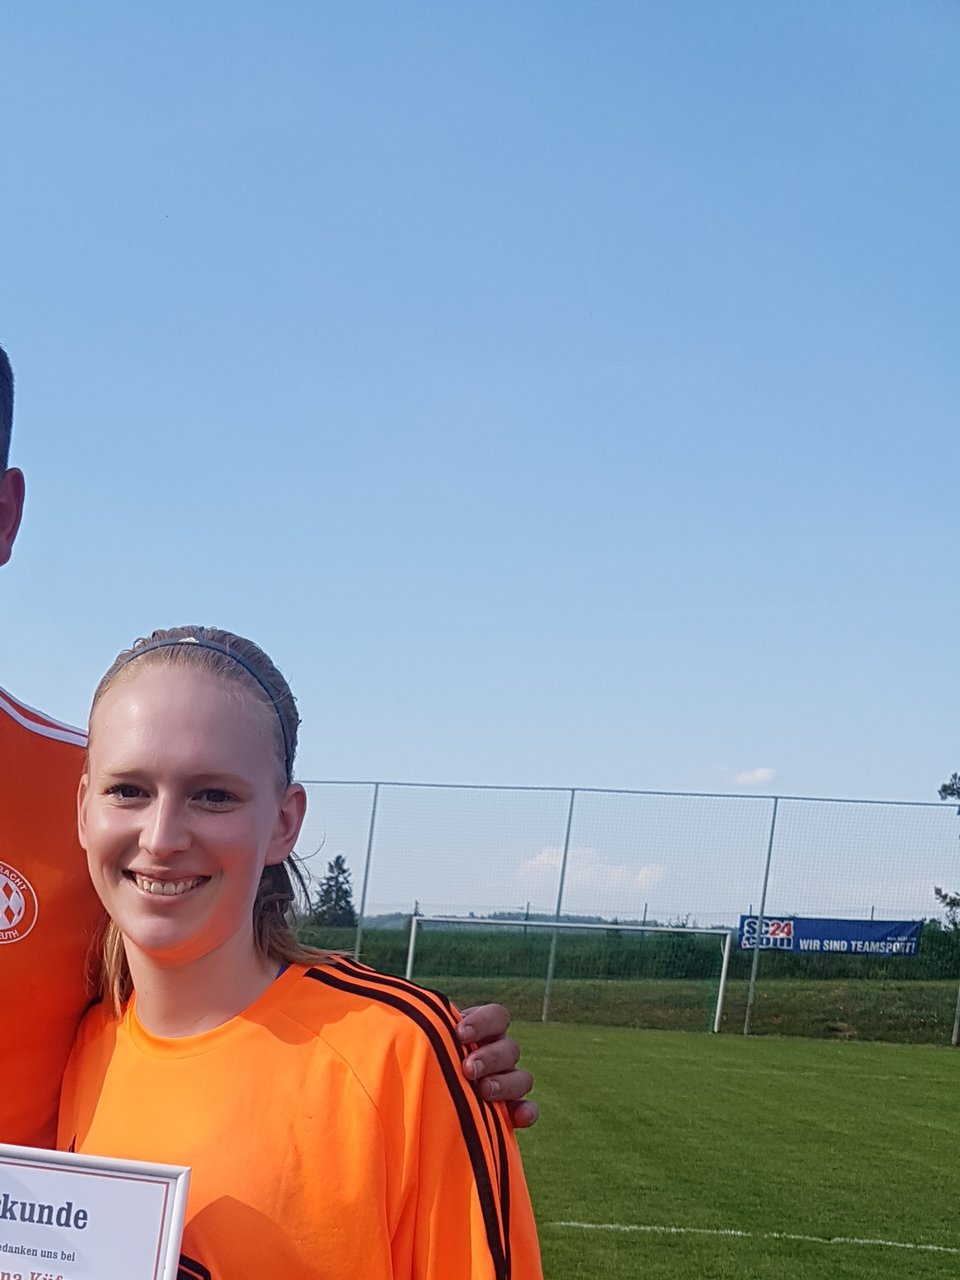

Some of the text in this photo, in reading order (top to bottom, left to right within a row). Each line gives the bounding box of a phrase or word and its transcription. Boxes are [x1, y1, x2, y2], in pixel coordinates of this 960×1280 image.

[799, 938, 820, 951] WIR
[823, 939, 848, 951] SIND
[40, 1249, 58, 1259] uns
[60, 1251, 75, 1262] bei
